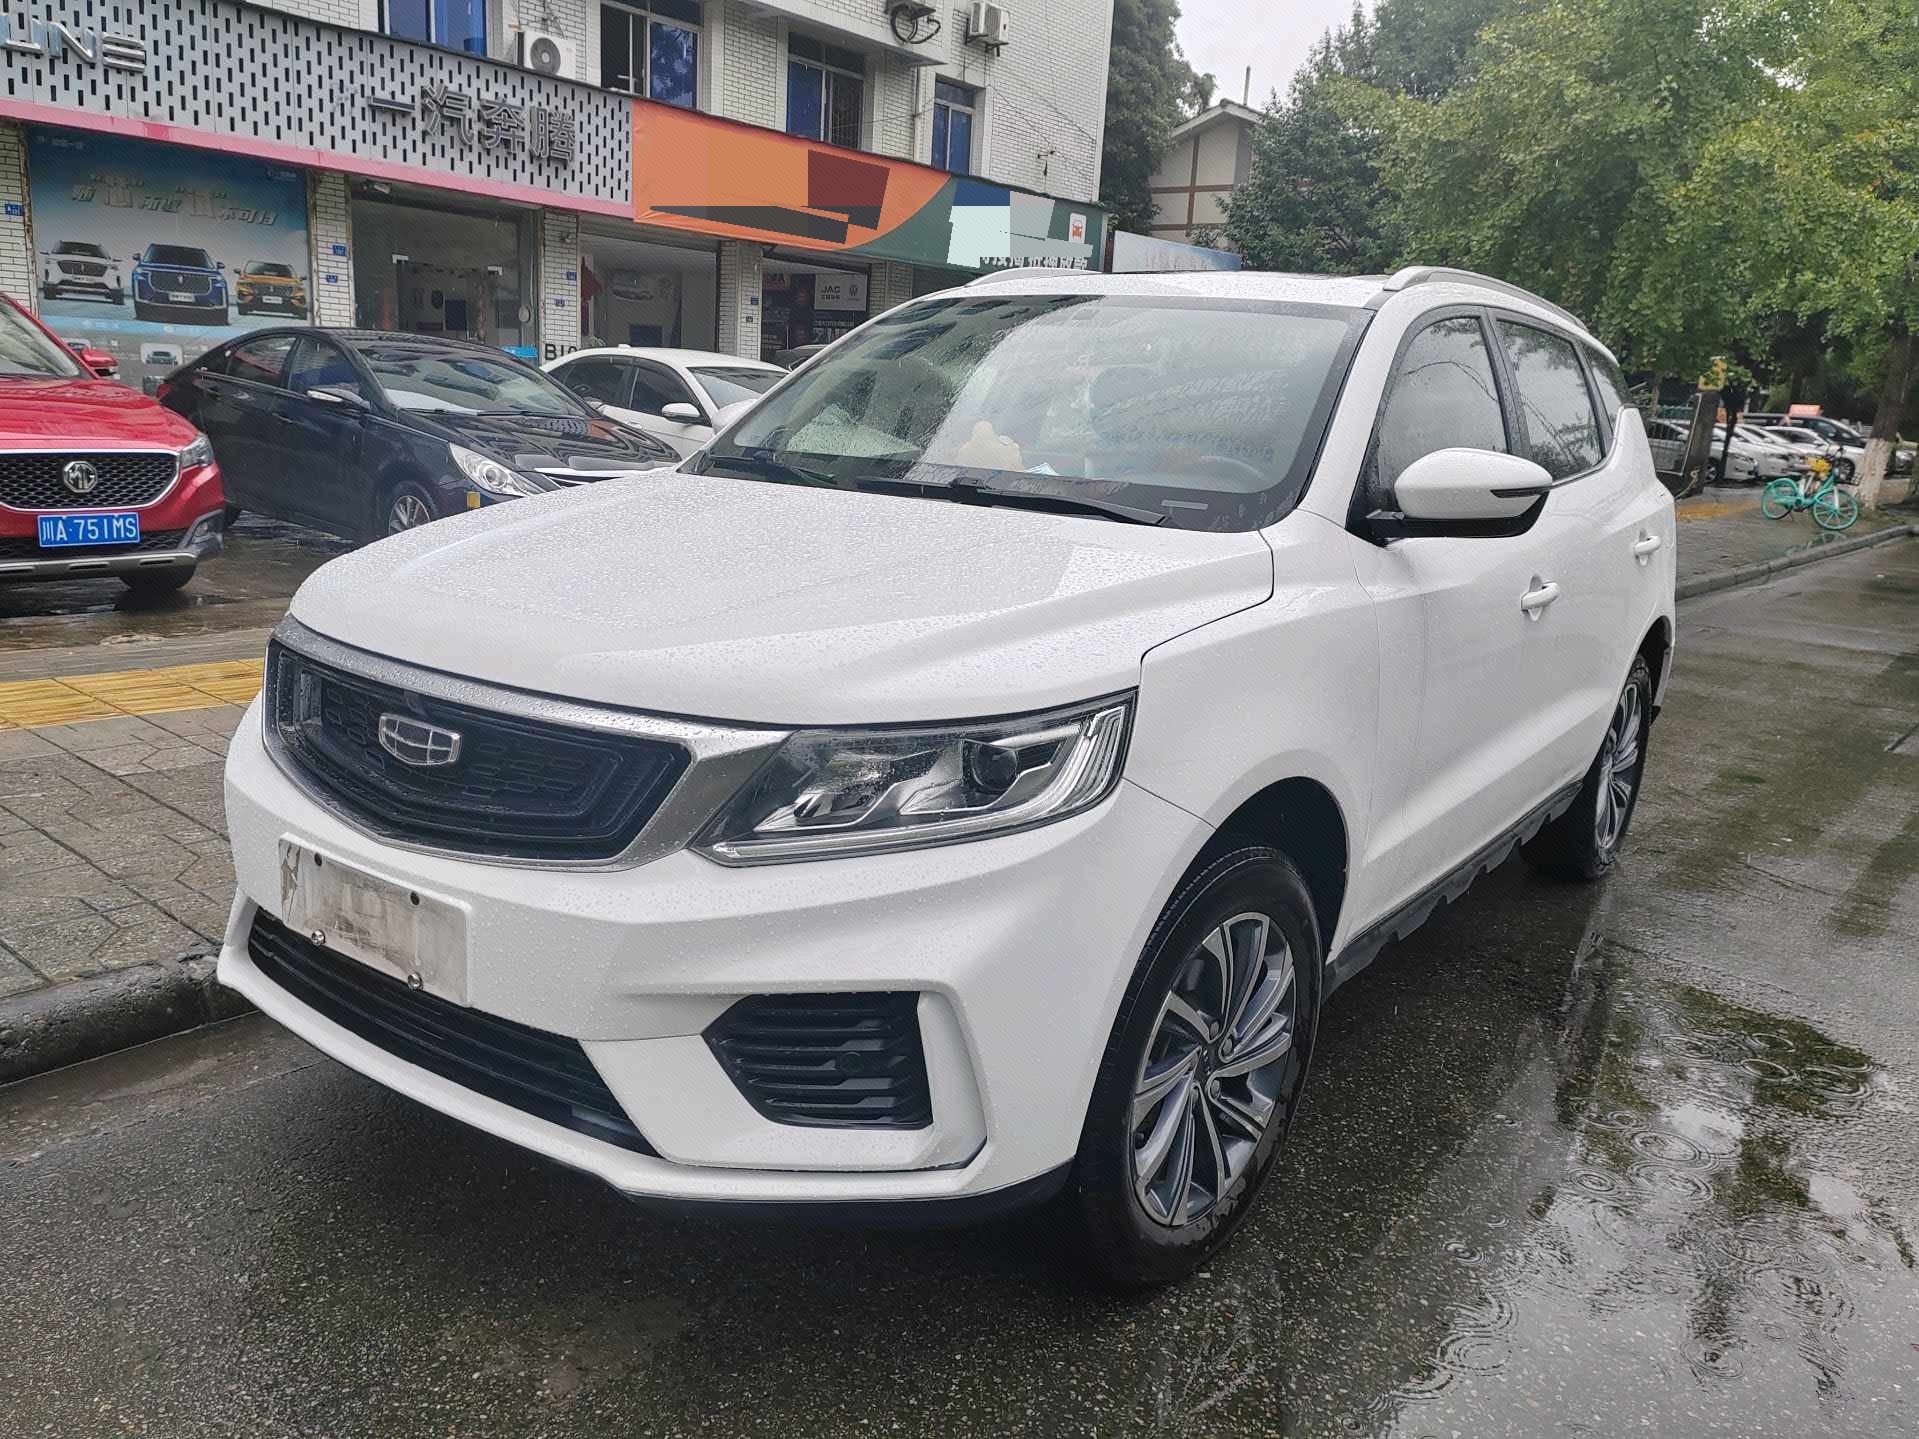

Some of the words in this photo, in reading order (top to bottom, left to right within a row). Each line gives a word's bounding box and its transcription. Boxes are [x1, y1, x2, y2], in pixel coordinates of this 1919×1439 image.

[366, 82, 576, 164] 一汽奔腾
[820, 285, 841, 294] JAC
